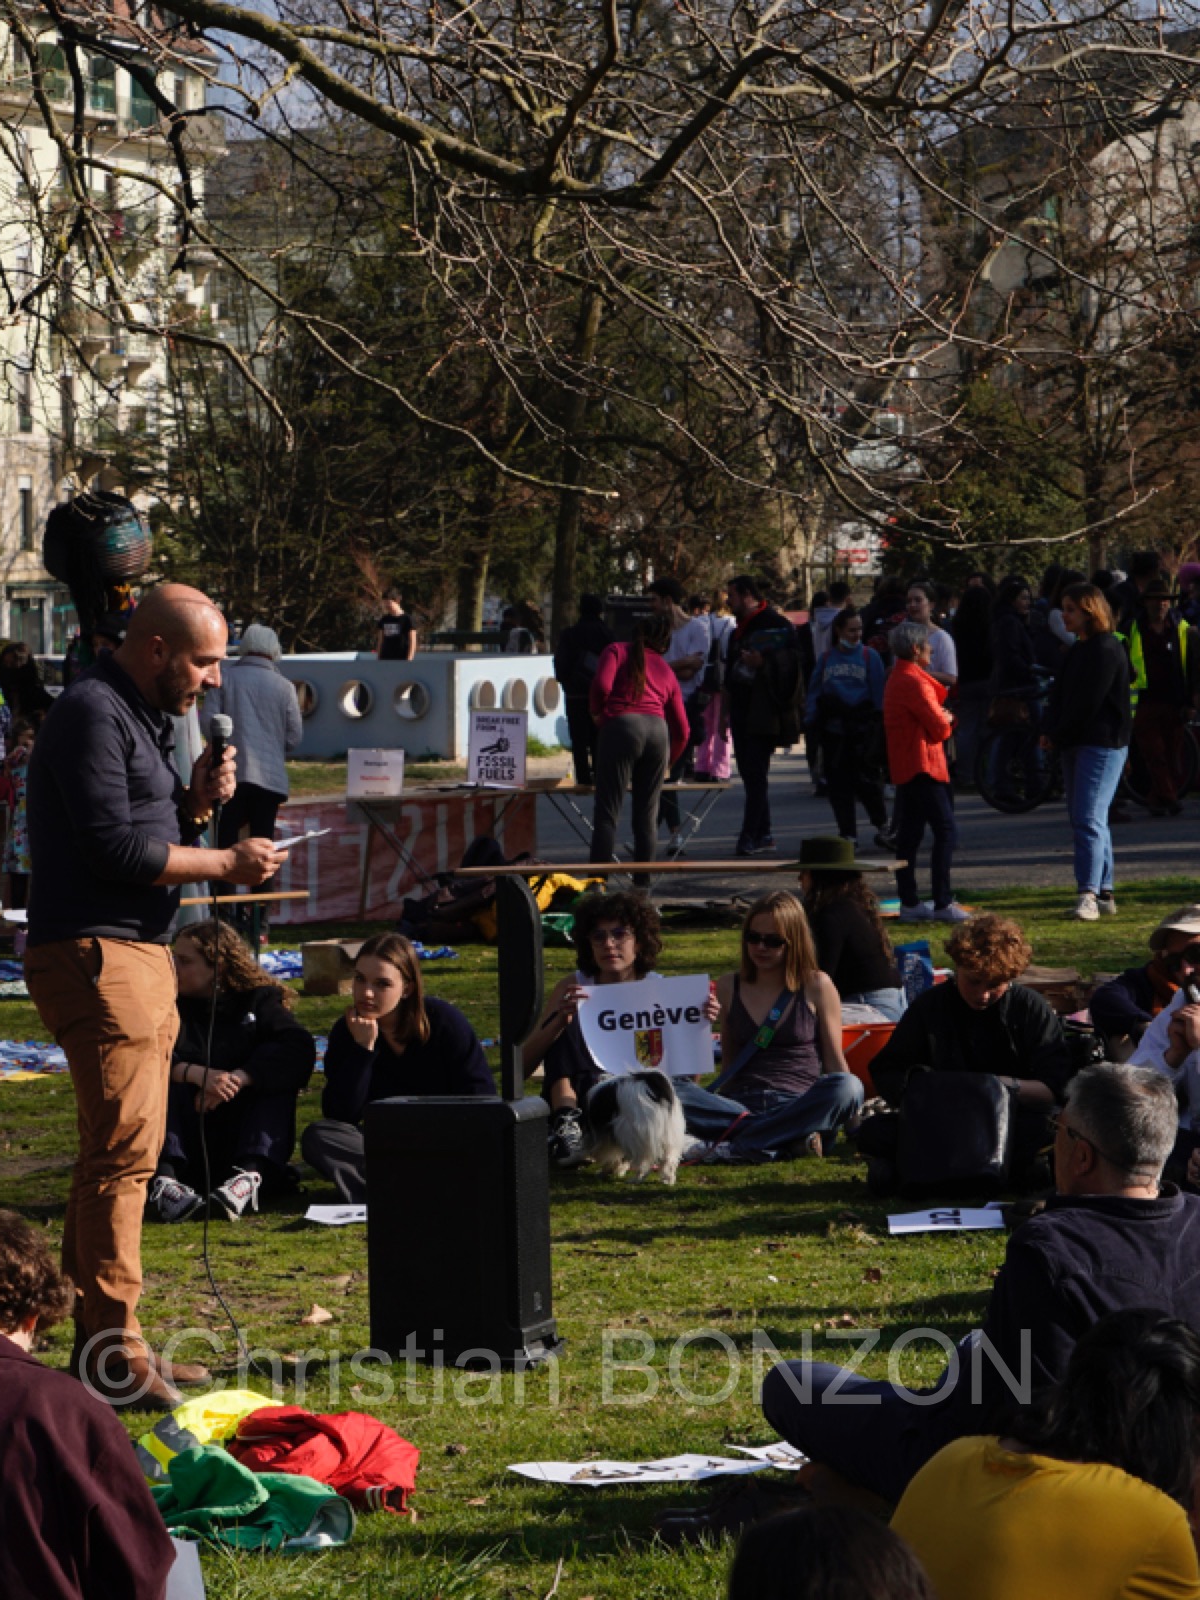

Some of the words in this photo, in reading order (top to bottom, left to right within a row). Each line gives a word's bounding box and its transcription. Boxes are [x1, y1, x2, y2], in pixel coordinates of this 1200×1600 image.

[500, 716, 521, 726] FREE
[477, 755, 517, 768] FOSSIL
[477, 768, 515, 781] FUELS
[598, 1004, 701, 1030] Genève
